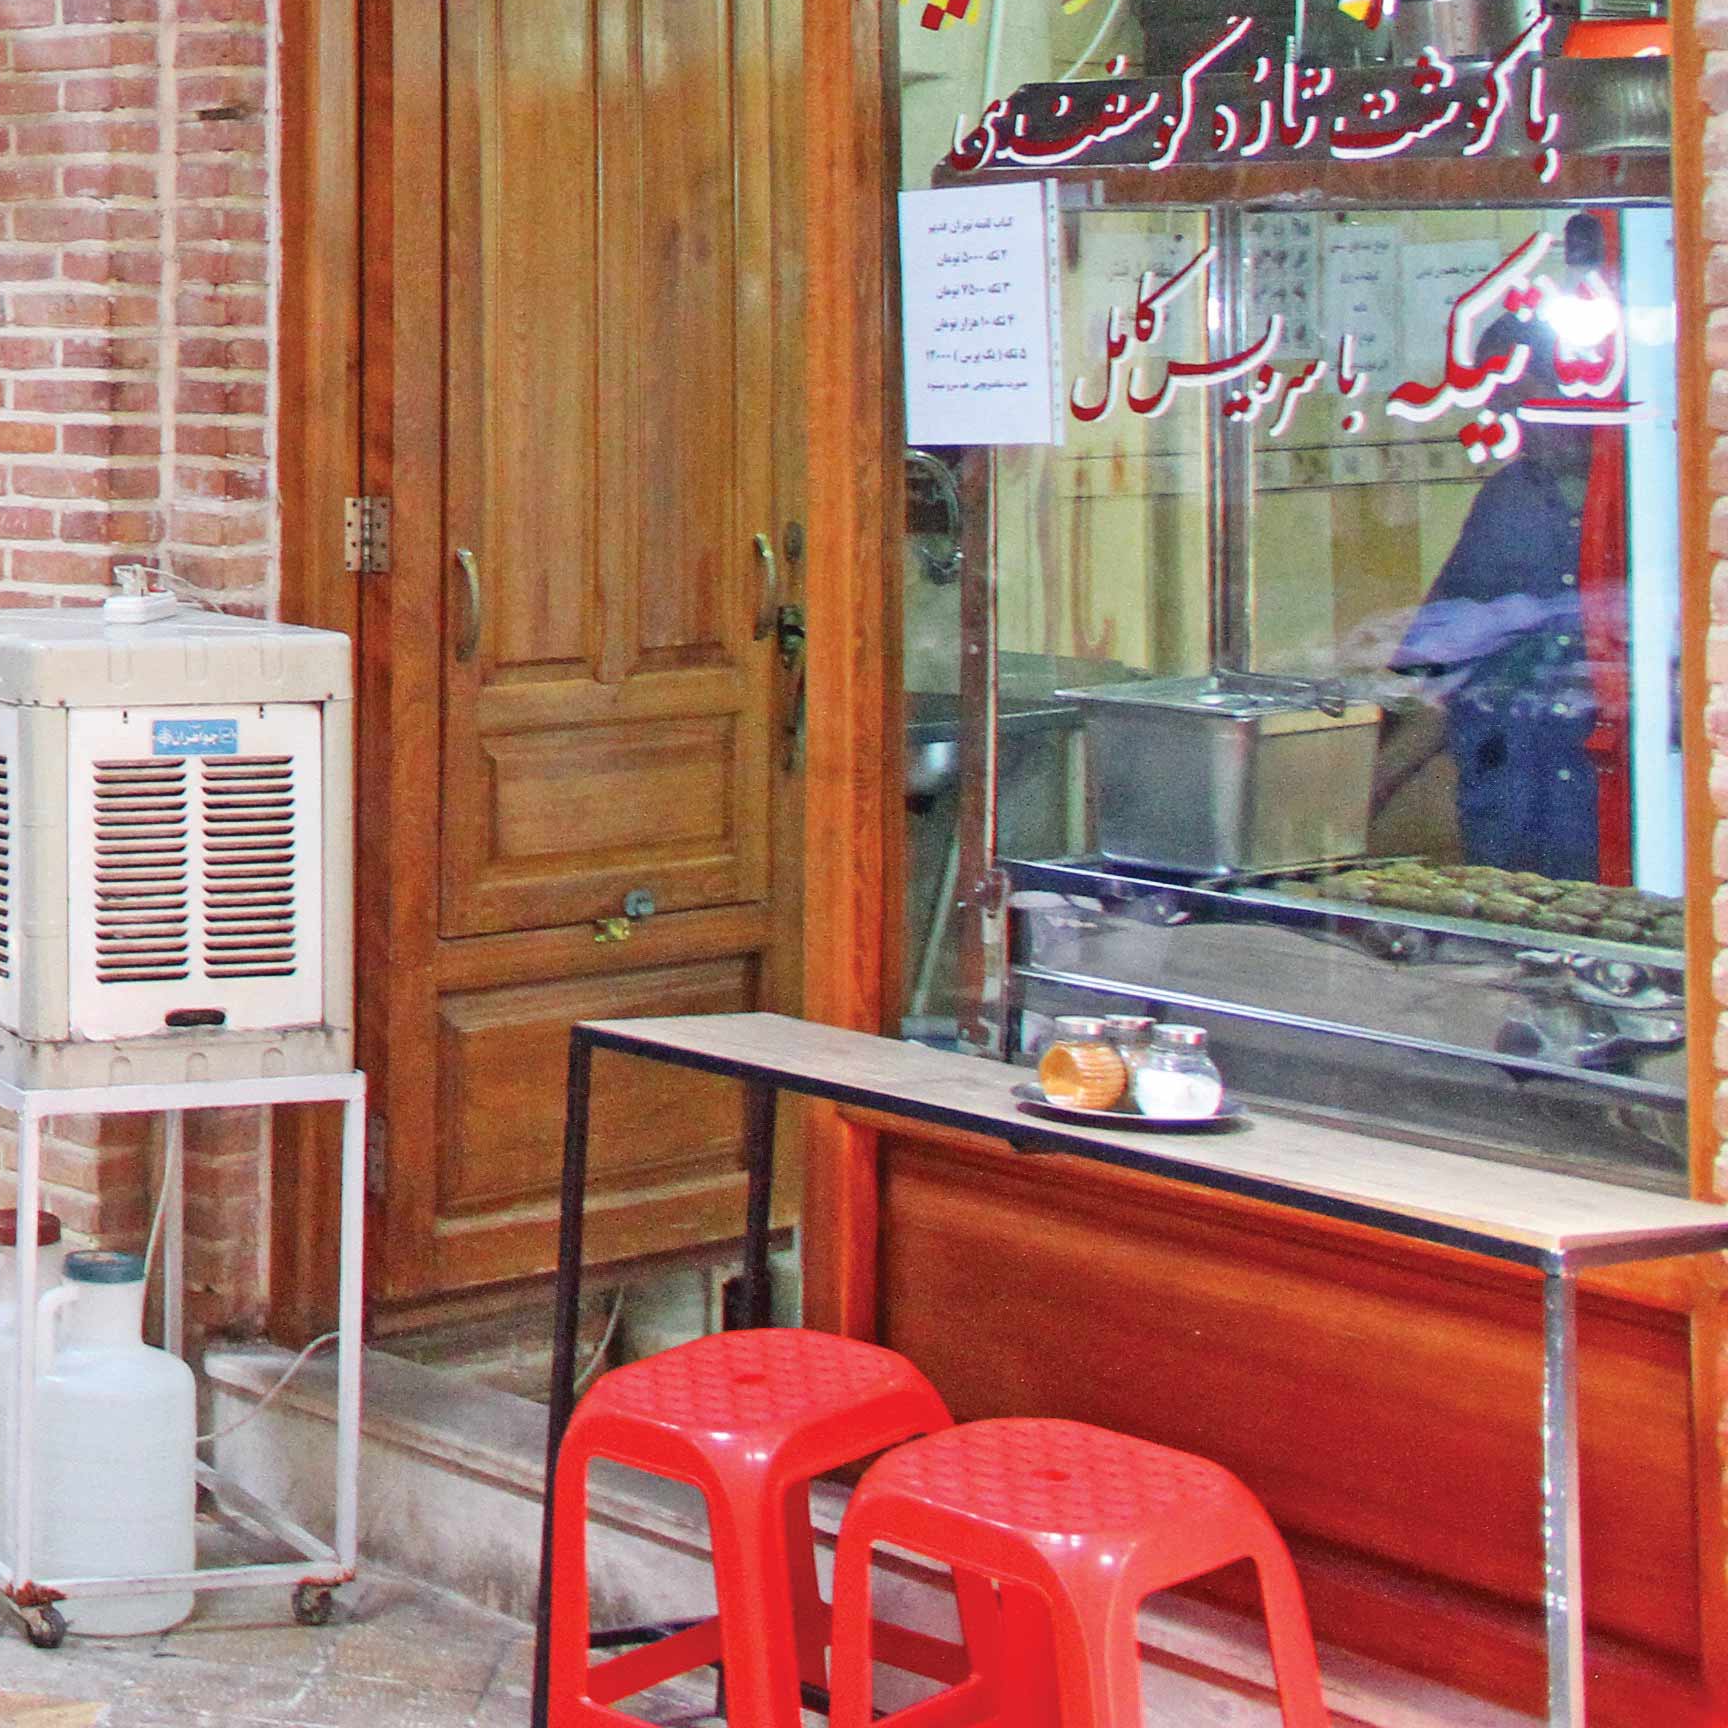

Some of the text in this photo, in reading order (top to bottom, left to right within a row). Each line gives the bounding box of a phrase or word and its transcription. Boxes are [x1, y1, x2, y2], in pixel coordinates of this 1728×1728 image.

[950, 15, 1562, 185] با گوشت تازه گوسفندی
[1069, 245, 1220, 423] کامل
[1126, 312, 1329, 439] سرویس
[1337, 333, 1370, 435] با
